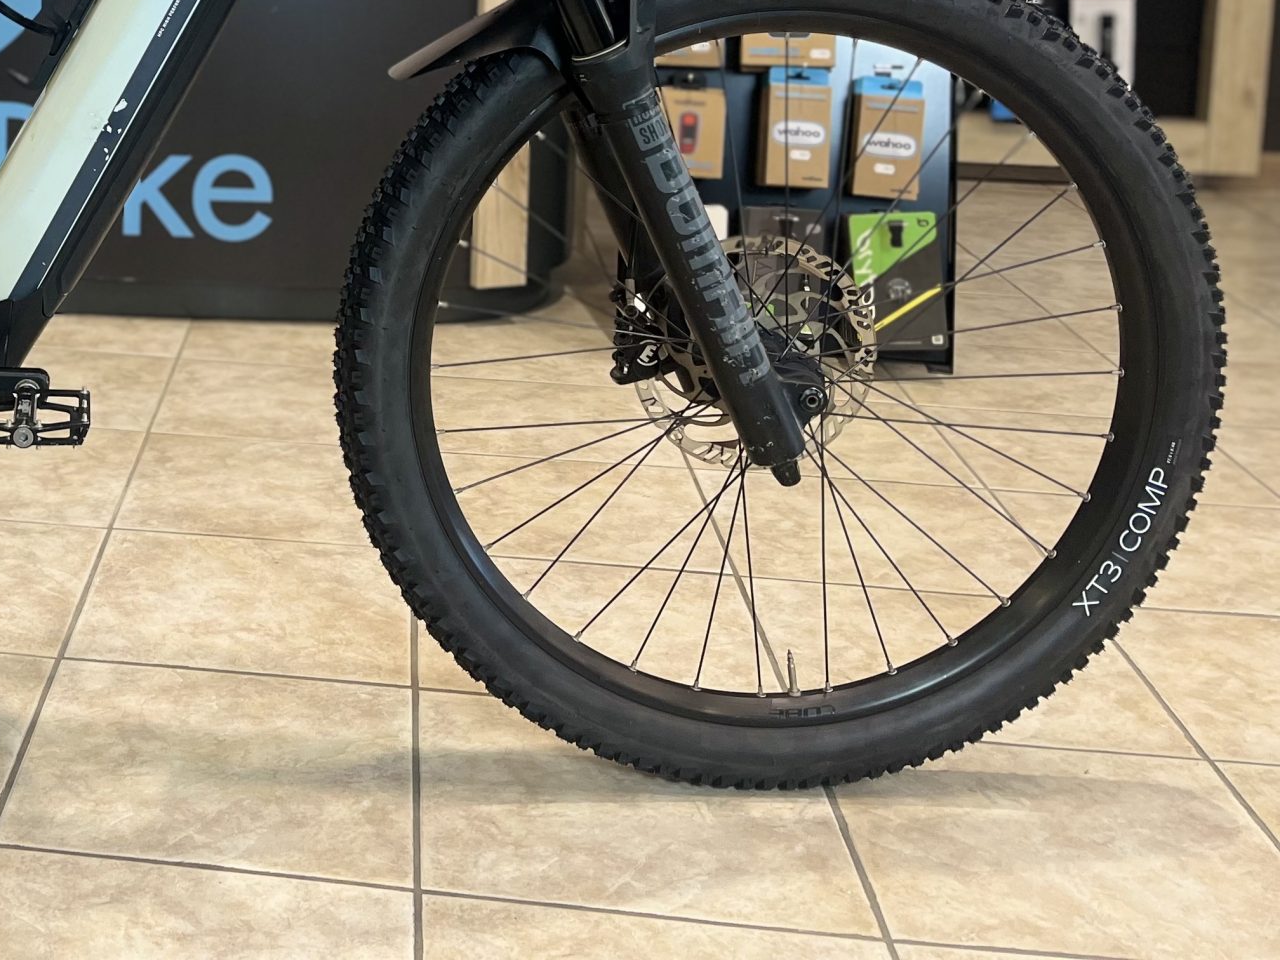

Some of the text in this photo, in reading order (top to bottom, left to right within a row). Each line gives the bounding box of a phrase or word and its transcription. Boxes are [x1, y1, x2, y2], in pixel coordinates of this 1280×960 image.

[777, 126, 822, 139] wahoo
[867, 137, 912, 152] wahoo
[1072, 467, 1168, 617] XT3 COMP
